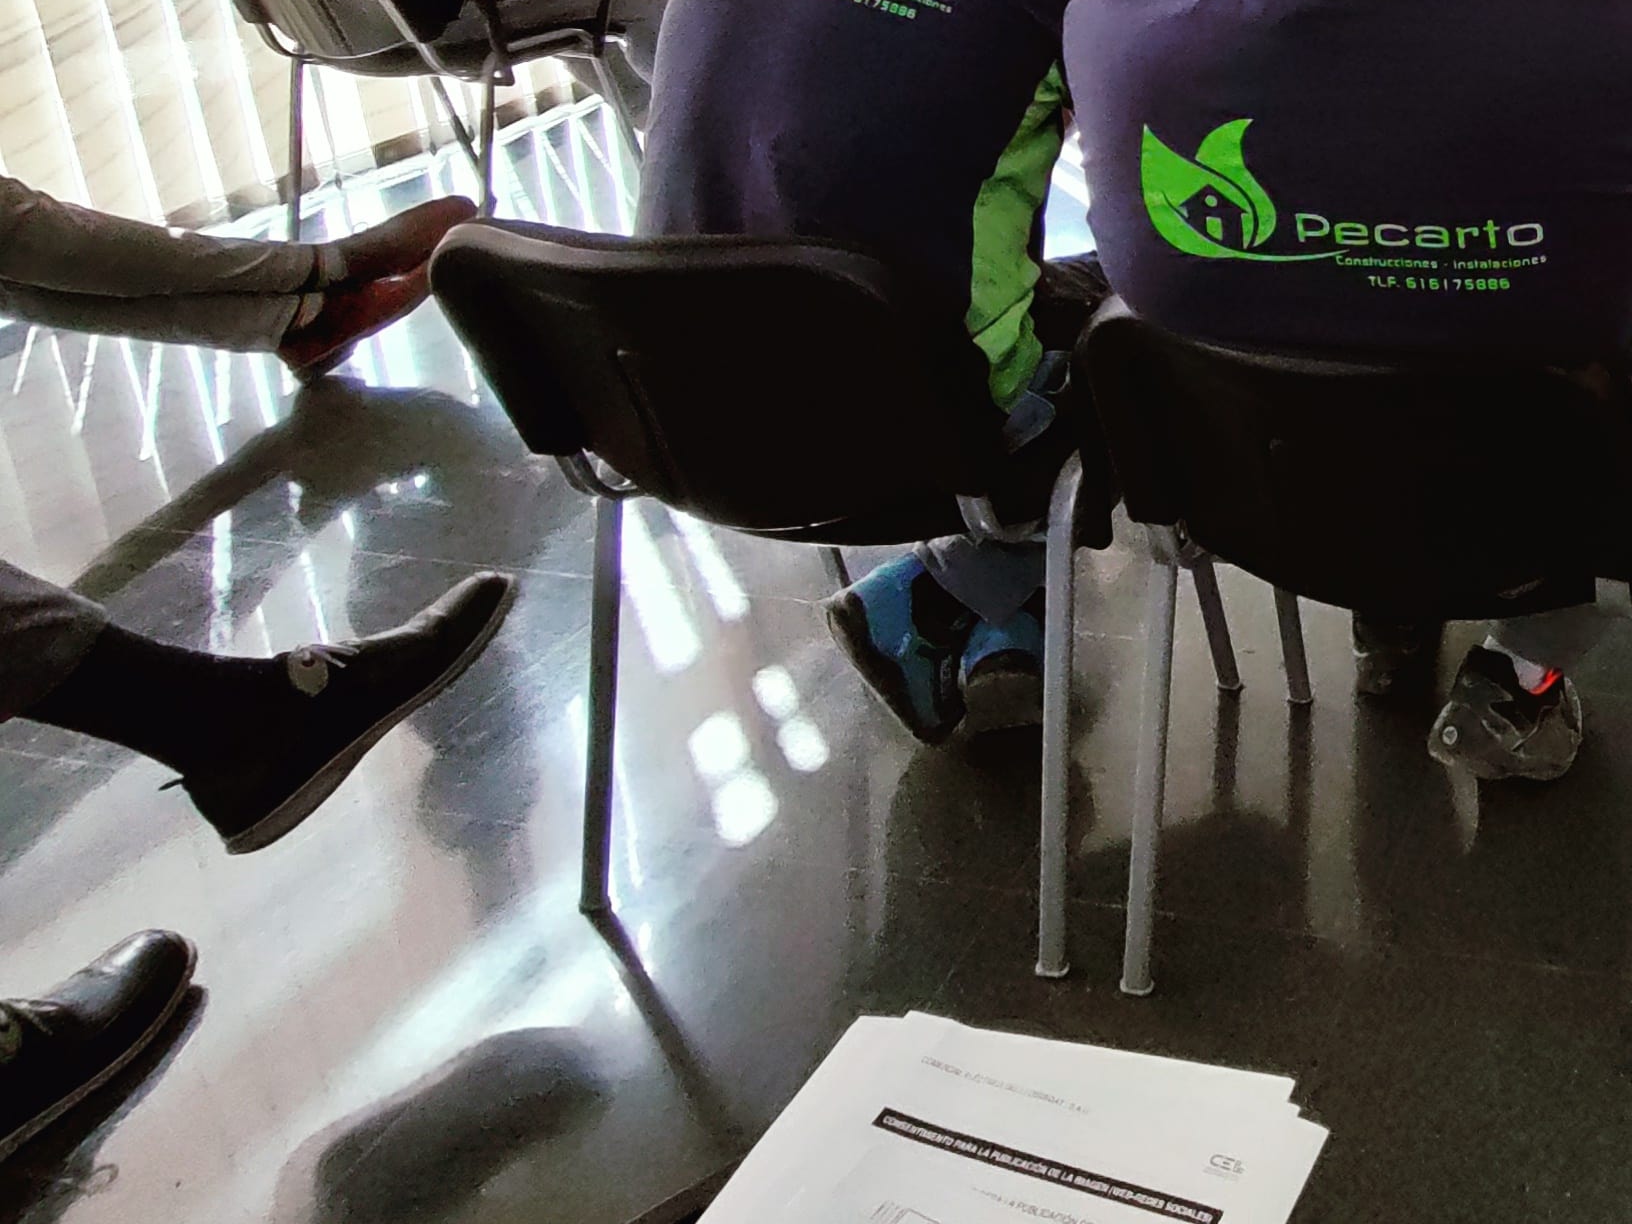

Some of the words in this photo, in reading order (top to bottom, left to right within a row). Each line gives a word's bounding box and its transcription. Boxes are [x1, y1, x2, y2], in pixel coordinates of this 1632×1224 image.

[1294, 212, 1545, 250] Pecarto
[1335, 255, 1438, 269] Construcciones
[1367, 275, 1400, 288] TLF.
[952, 1139, 978, 1154] PARA
[990, 1150, 1048, 1176] PUBLICACIÓN
